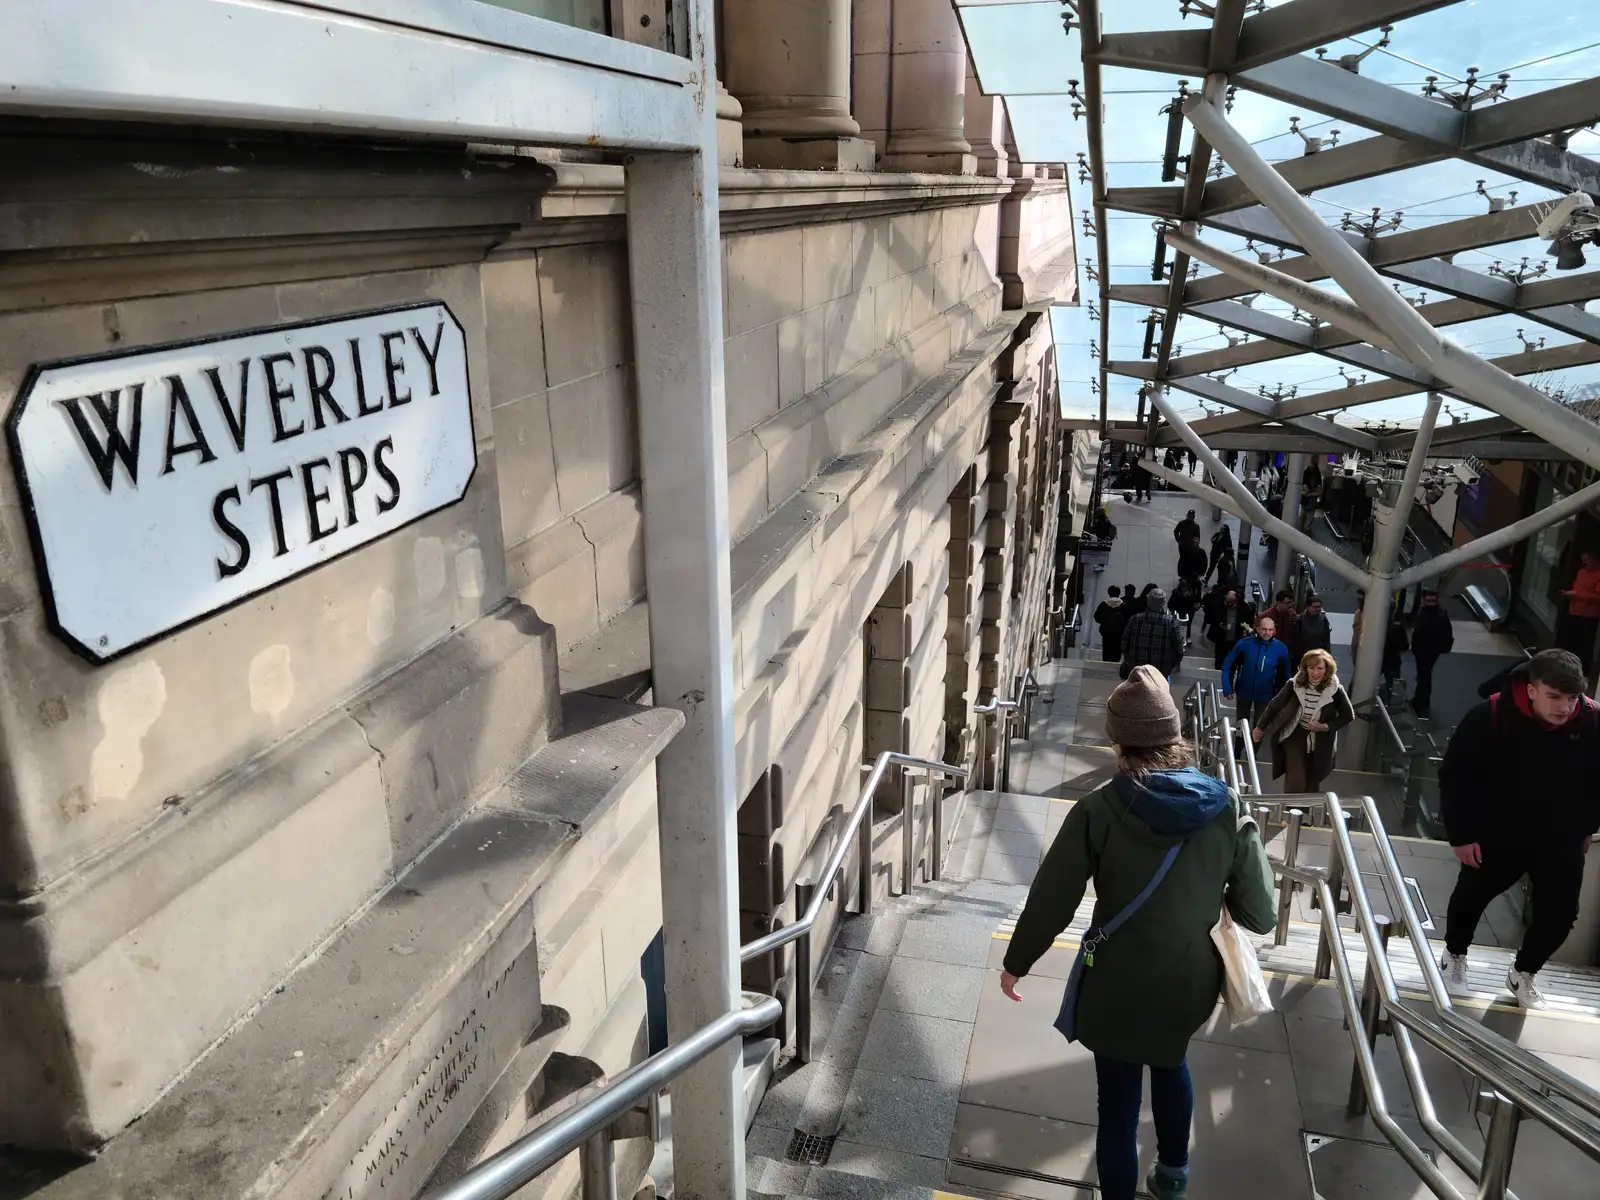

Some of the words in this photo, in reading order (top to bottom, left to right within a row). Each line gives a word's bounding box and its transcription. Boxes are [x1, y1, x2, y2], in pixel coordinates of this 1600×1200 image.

[55, 322, 445, 492] WAVERLEY
[213, 435, 401, 580] STEPS
[416, 1021, 486, 1116] ARCHITECTS
[423, 1054, 479, 1136] MASONRY
